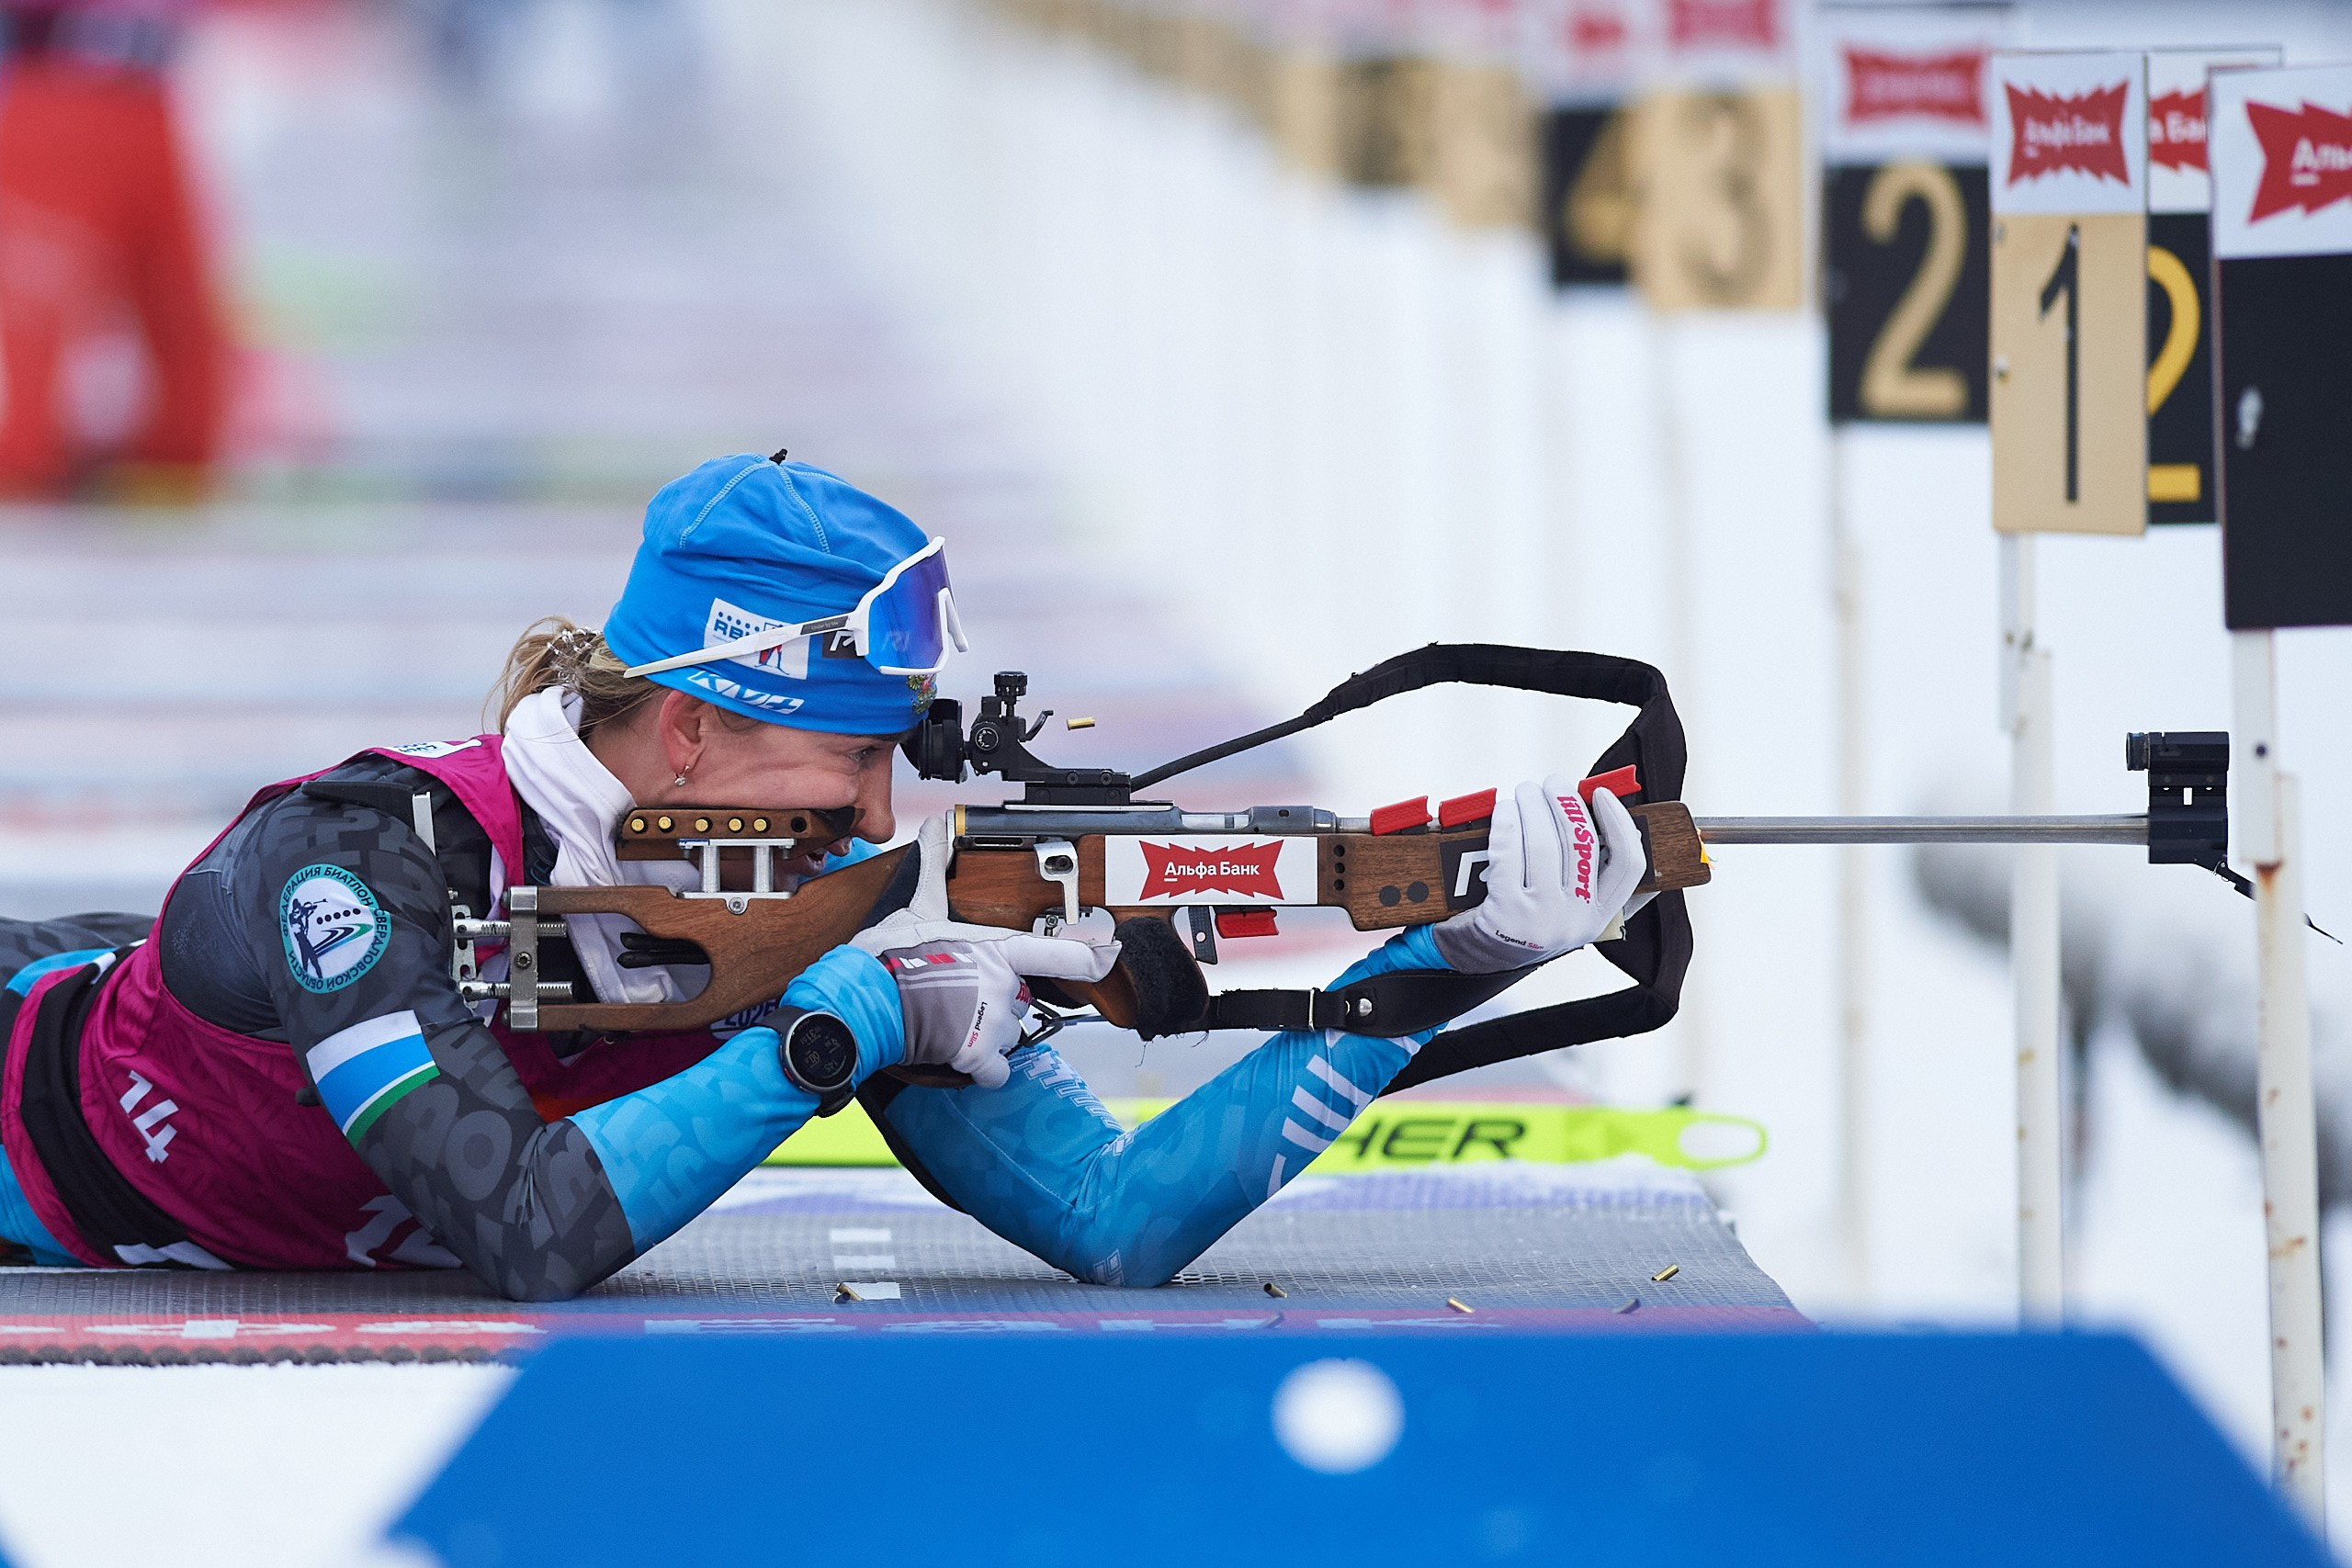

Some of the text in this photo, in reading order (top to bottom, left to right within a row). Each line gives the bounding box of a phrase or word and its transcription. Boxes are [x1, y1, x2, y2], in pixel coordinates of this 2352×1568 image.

[1860, 161, 1968, 417] 2
[2039, 222, 2078, 502] 1
[2148, 244, 2201, 502] 2
[1165, 861, 1260, 880] Альфа Банк
[1495, 930, 1527, 947] Legend
[974, 1001, 988, 1031] Legend
[119, 1070, 179, 1164] 14
